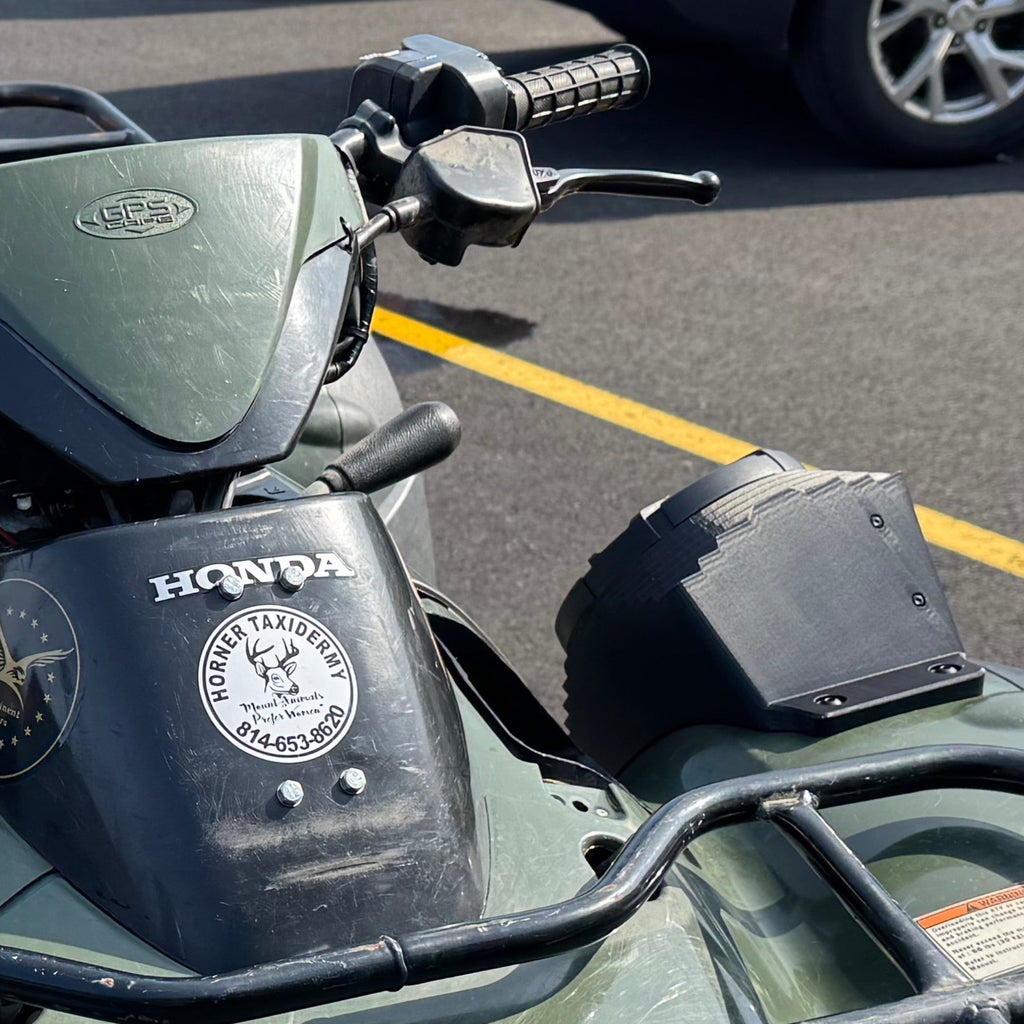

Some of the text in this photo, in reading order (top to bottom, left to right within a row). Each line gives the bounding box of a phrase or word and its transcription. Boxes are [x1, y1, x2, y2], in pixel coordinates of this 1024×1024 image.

[100, 198, 172, 222] GPS
[149, 552, 355, 602] HONDA
[208, 614, 347, 703] HORNER TAXIDERMY
[236, 705, 345, 752] 814-653-8620
[252, 710, 284, 725] Prefer
